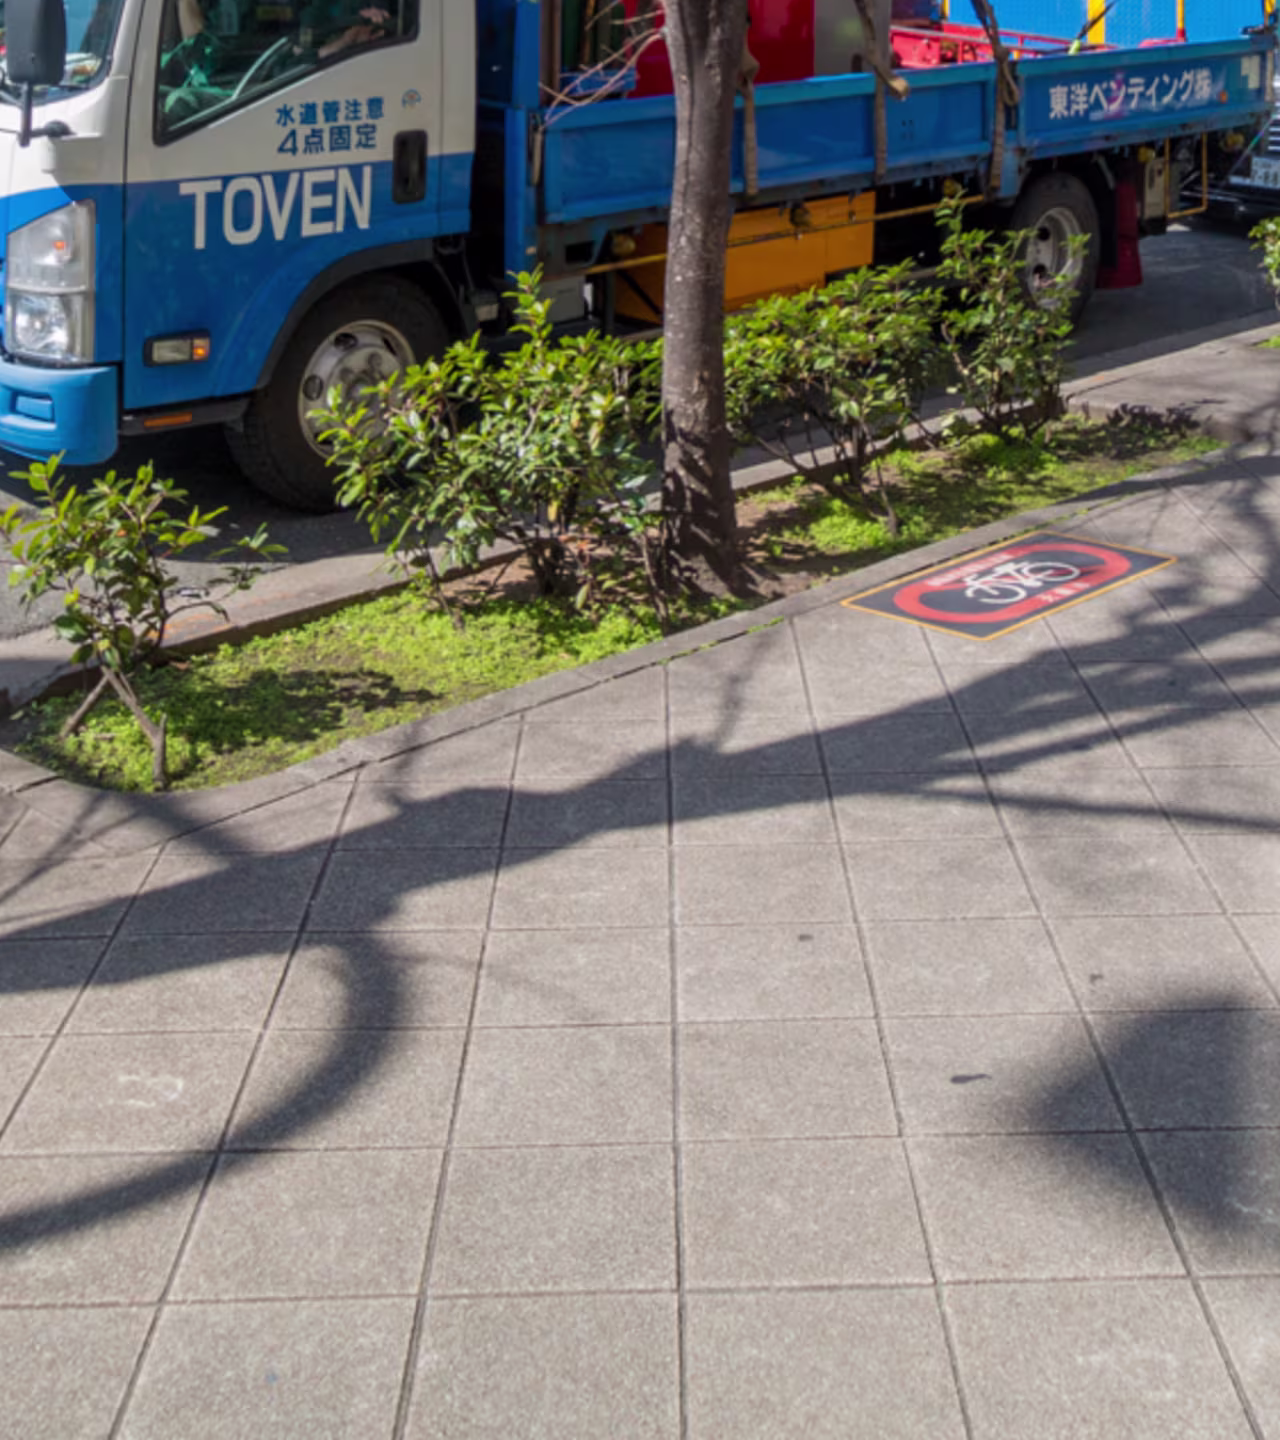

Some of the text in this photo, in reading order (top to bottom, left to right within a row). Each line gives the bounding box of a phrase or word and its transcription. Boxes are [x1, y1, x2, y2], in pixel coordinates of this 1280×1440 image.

[276, 96, 384, 127] 水道管注意
[277, 123, 377, 156] 4点固定
[179, 165, 372, 250] TOVEN
